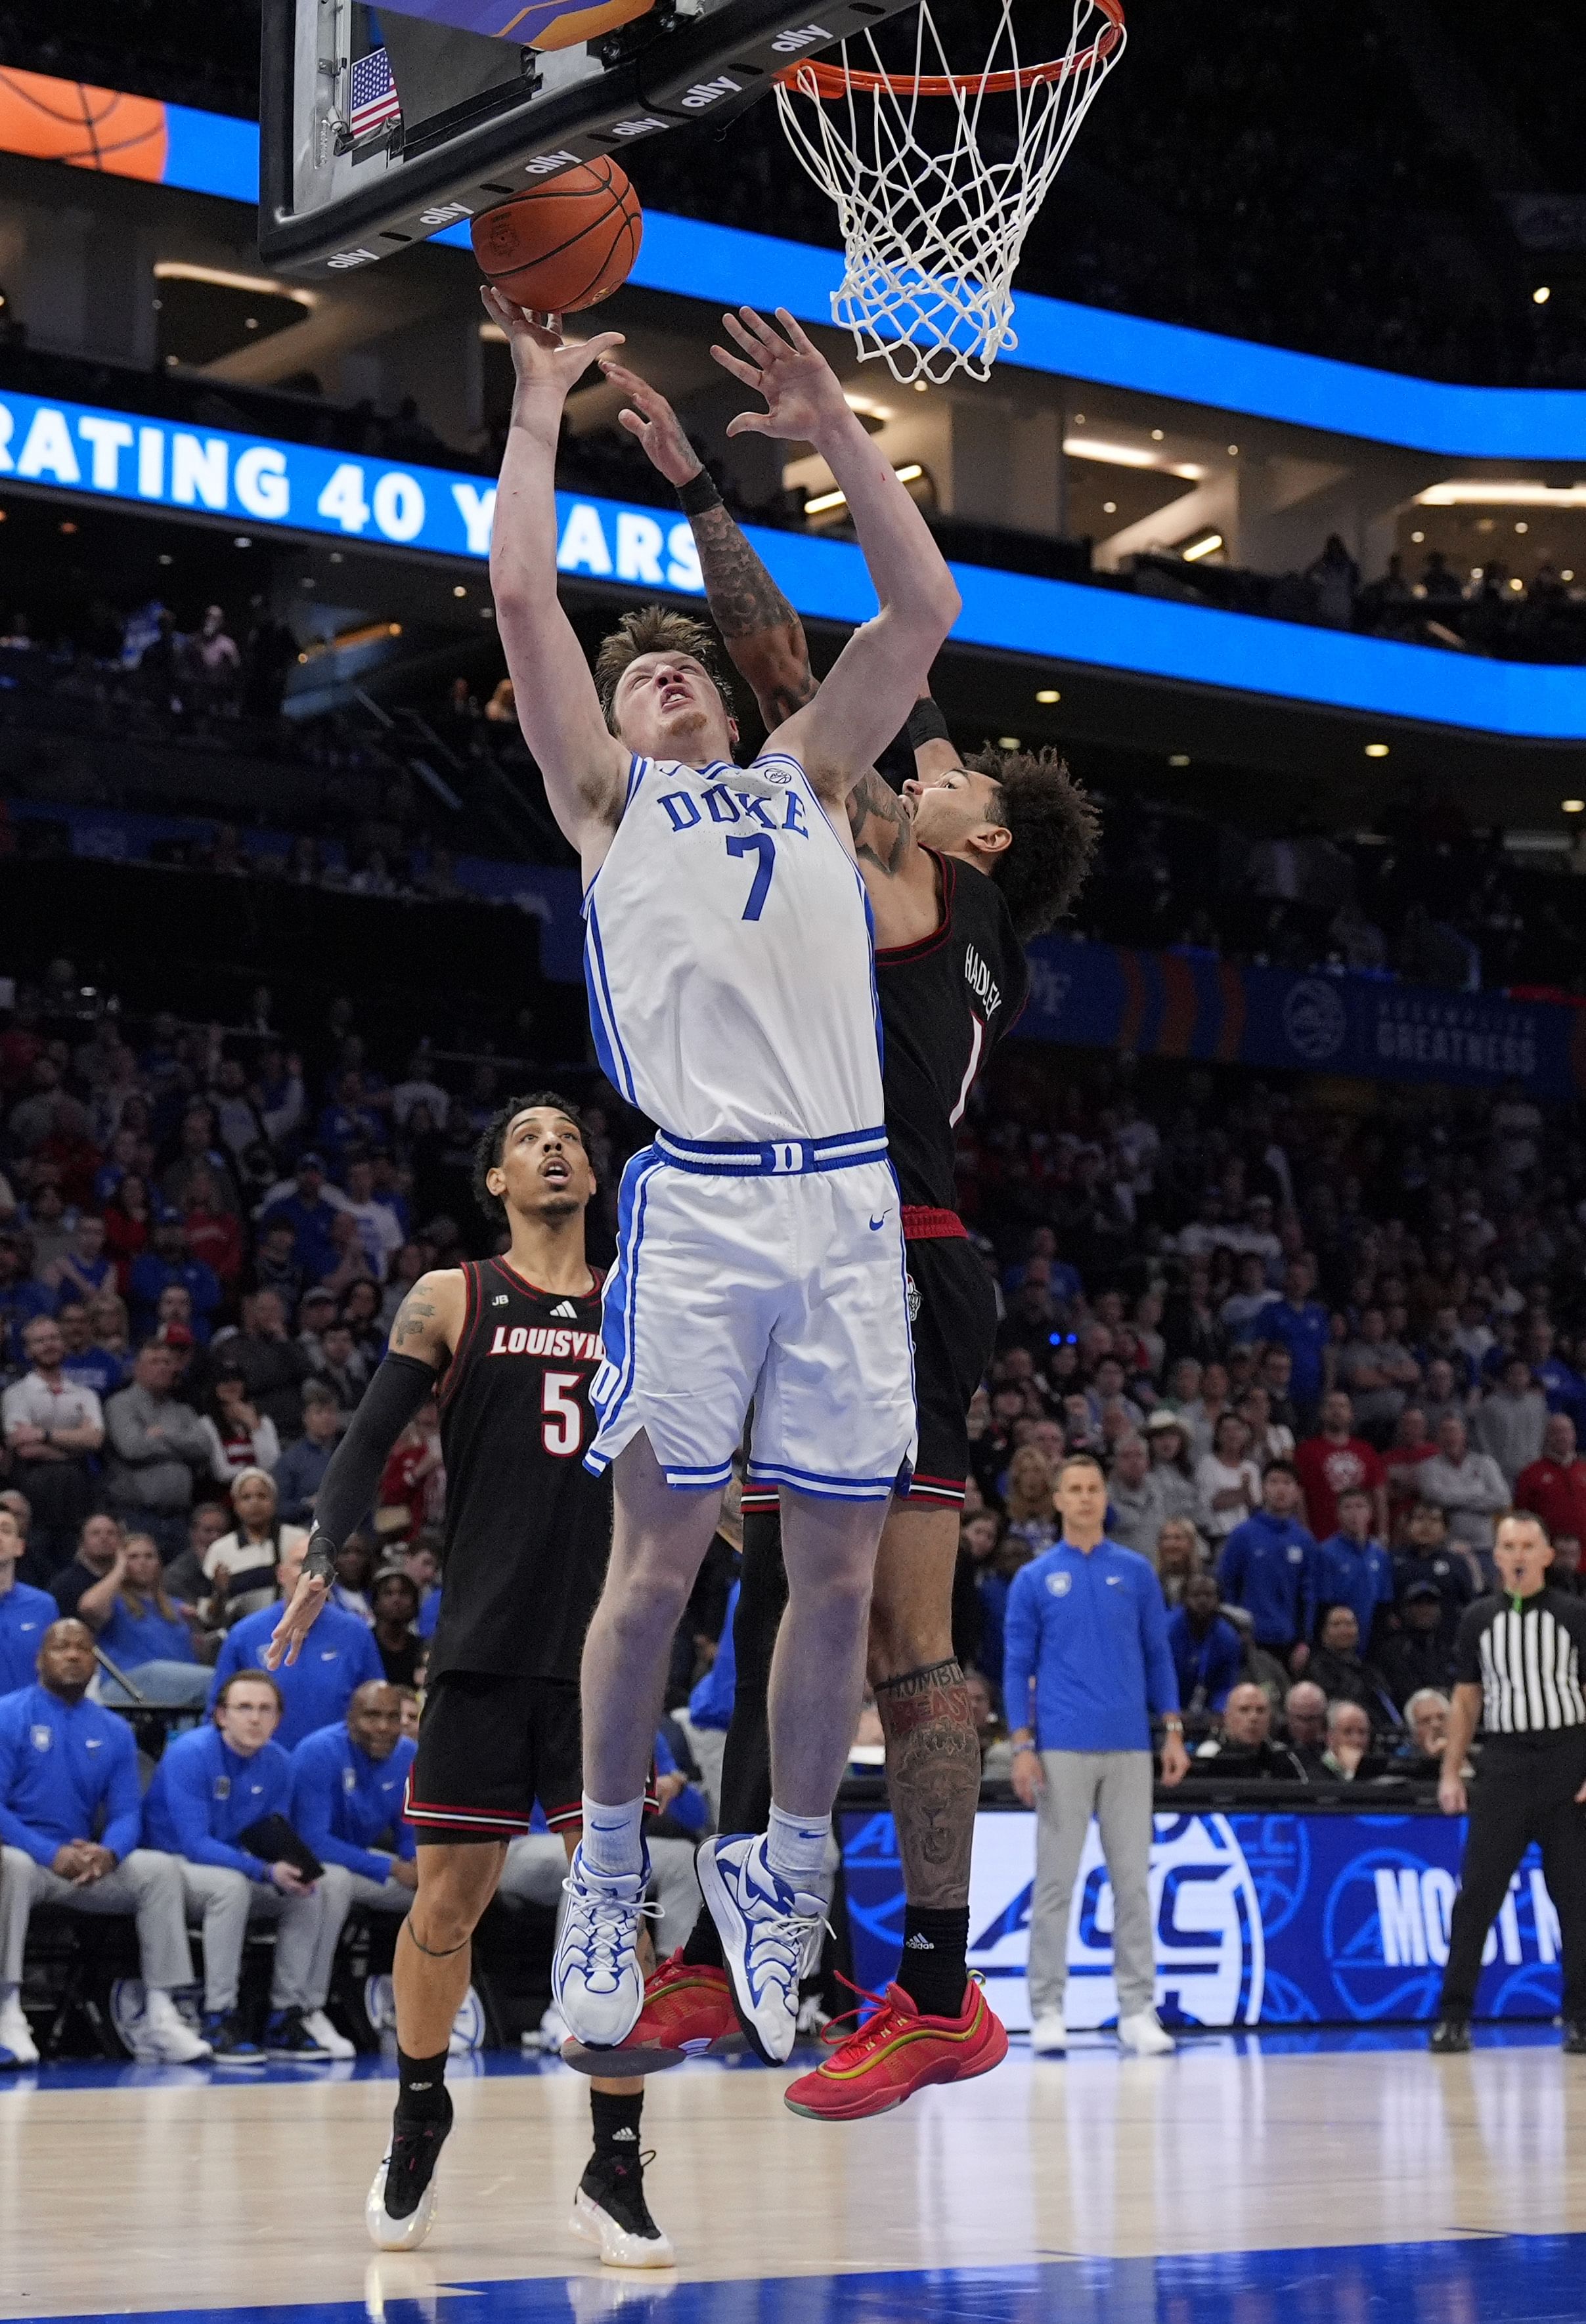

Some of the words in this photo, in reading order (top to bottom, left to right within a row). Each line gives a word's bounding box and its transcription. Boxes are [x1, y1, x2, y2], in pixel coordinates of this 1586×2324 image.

[771, 24, 833, 53] ally
[681, 76, 743, 108] ally
[612, 118, 669, 137] ally
[525, 150, 583, 174] ally
[420, 202, 474, 225] ally
[327, 248, 380, 269] ally
[317, 462, 426, 542] 40
[451, 483, 706, 592] YARS
[657, 783, 809, 840] DUKE
[726, 832, 776, 921] 7
[965, 943, 1002, 1021] HADLEY
[772, 1142, 803, 1172] D
[541, 1369, 585, 1457] 5
[906, 1940, 935, 1950] adidas
